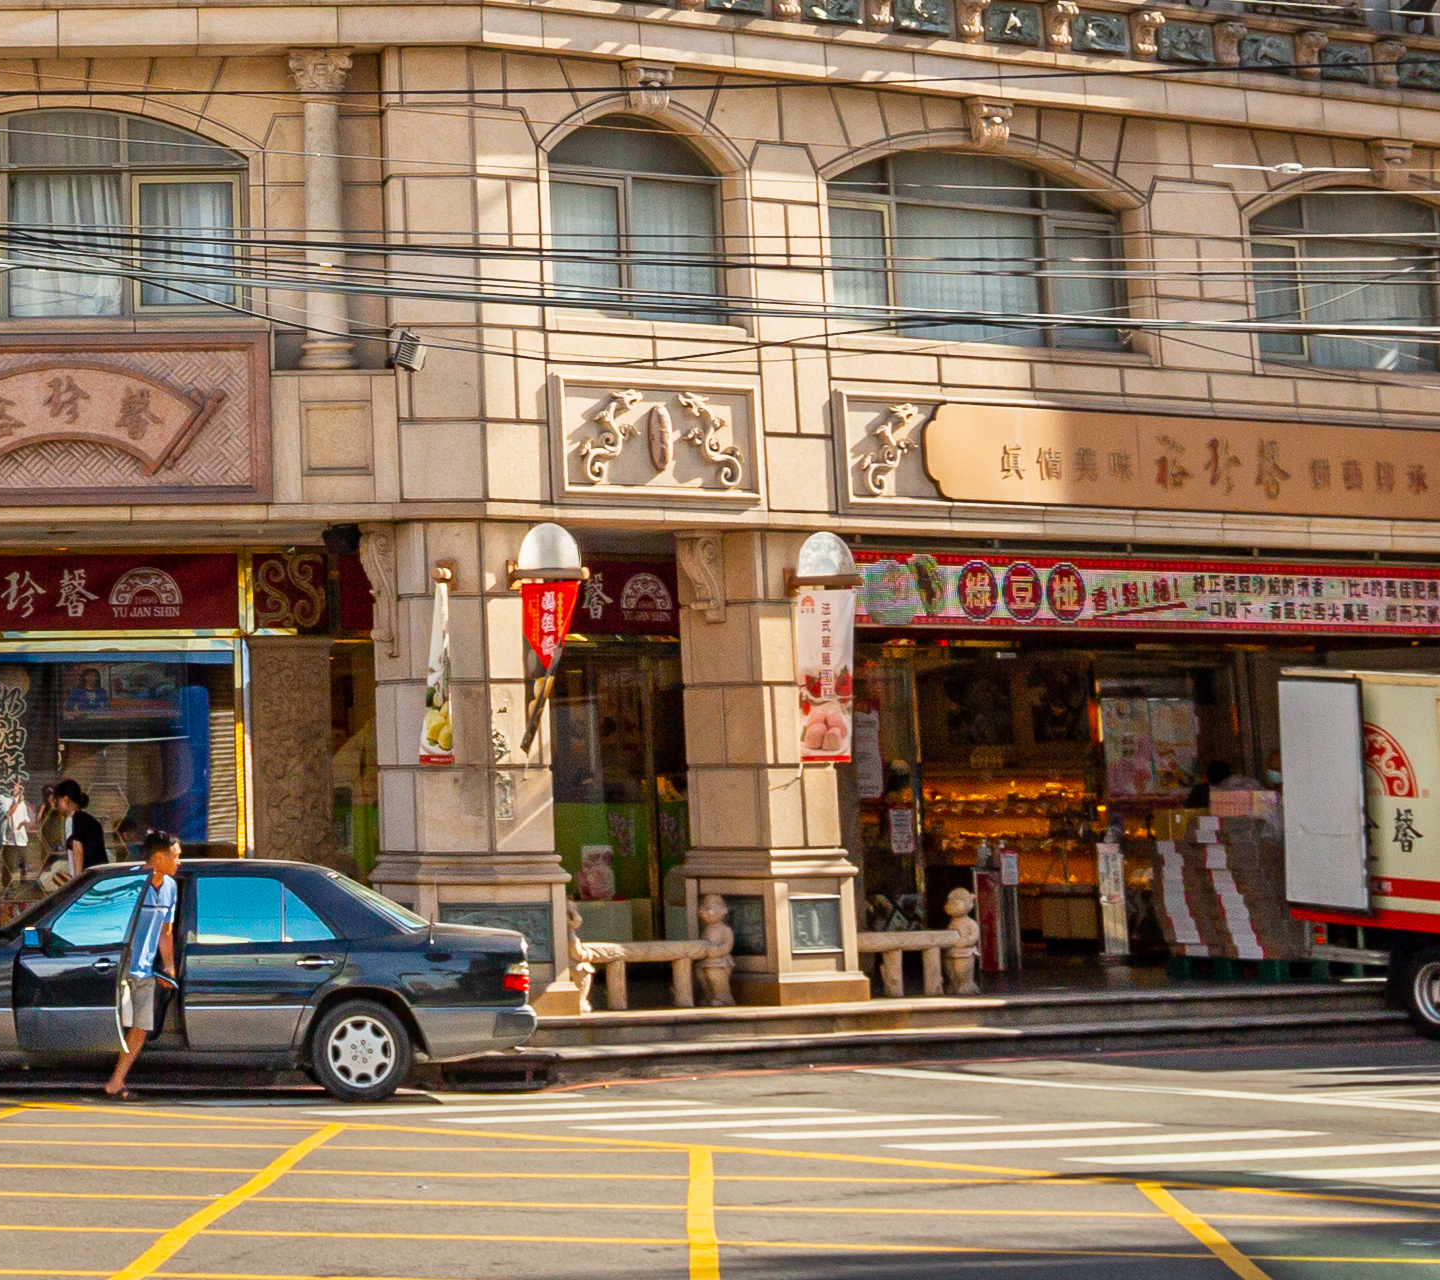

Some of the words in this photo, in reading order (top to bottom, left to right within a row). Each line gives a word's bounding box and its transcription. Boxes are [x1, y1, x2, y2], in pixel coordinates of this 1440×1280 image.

[112, 607, 128, 618] YU
[130, 607, 151, 618] JAN
[154, 606, 180, 617] SHIN
